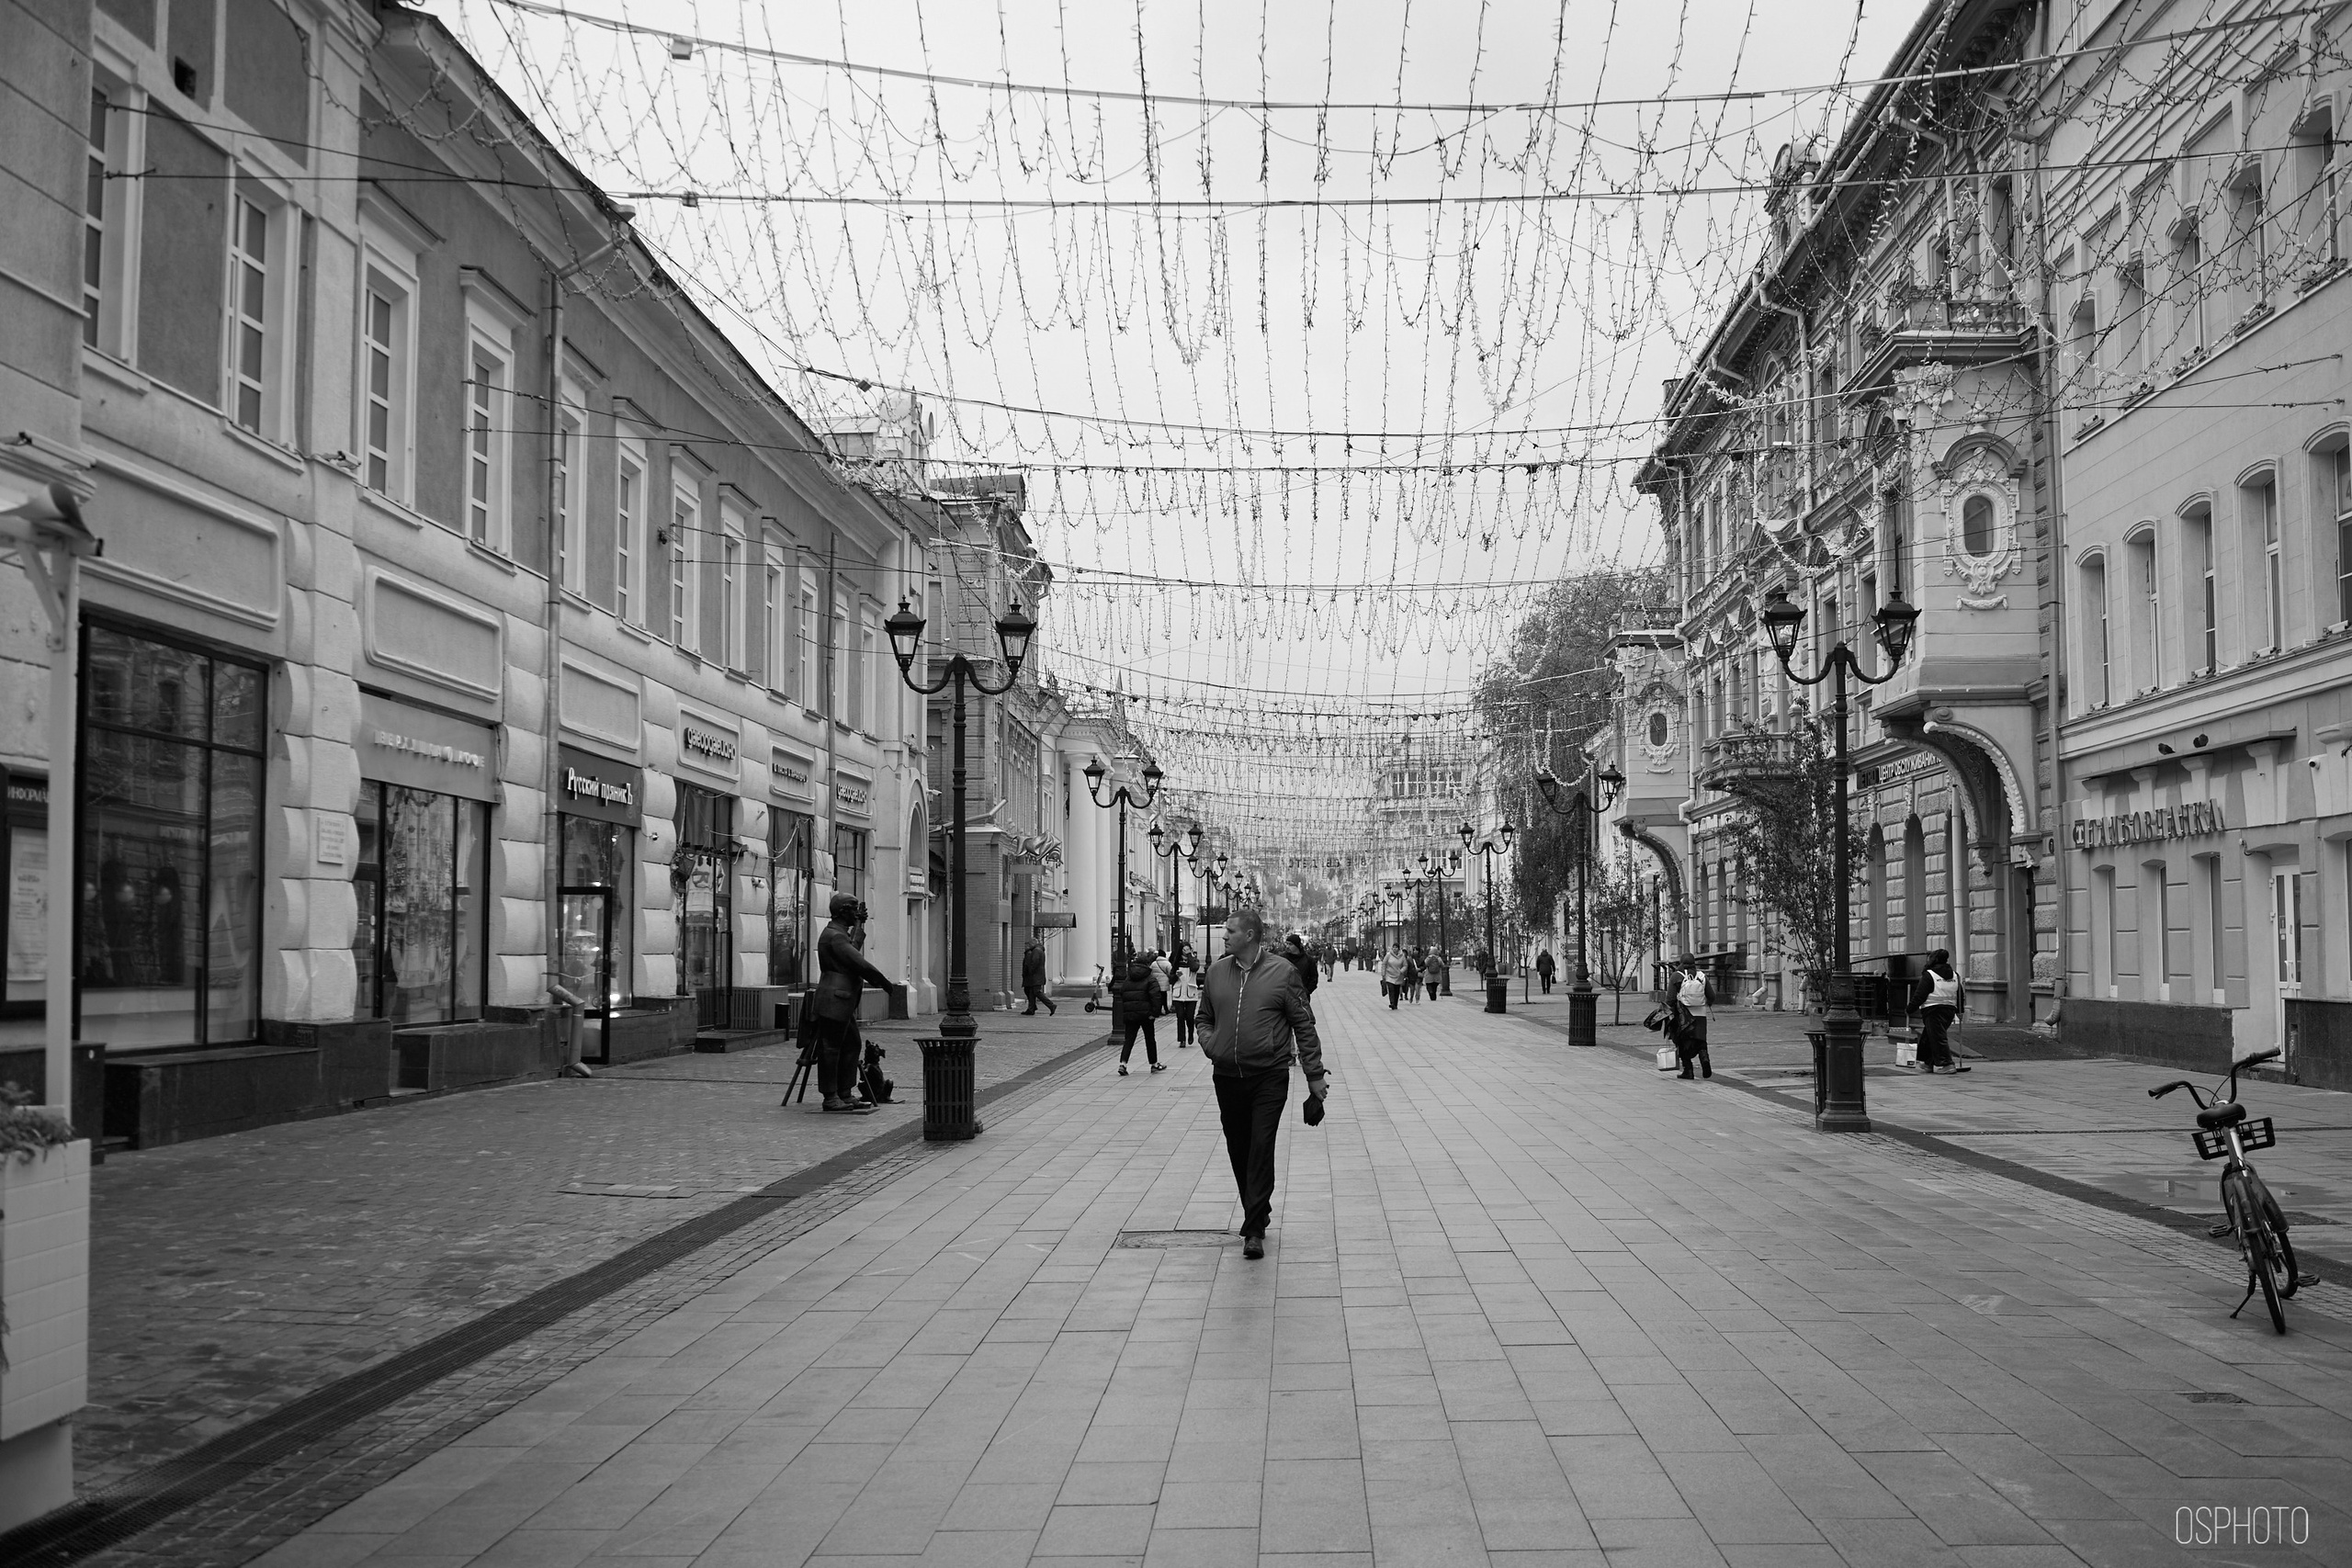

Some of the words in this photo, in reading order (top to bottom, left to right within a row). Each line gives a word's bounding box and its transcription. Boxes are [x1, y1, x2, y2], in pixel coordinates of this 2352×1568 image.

[567, 767, 600, 800] Русский
[1879, 763, 1894, 784] ЦЕНТР
[7, 785, 49, 803] ИНФОРМА
